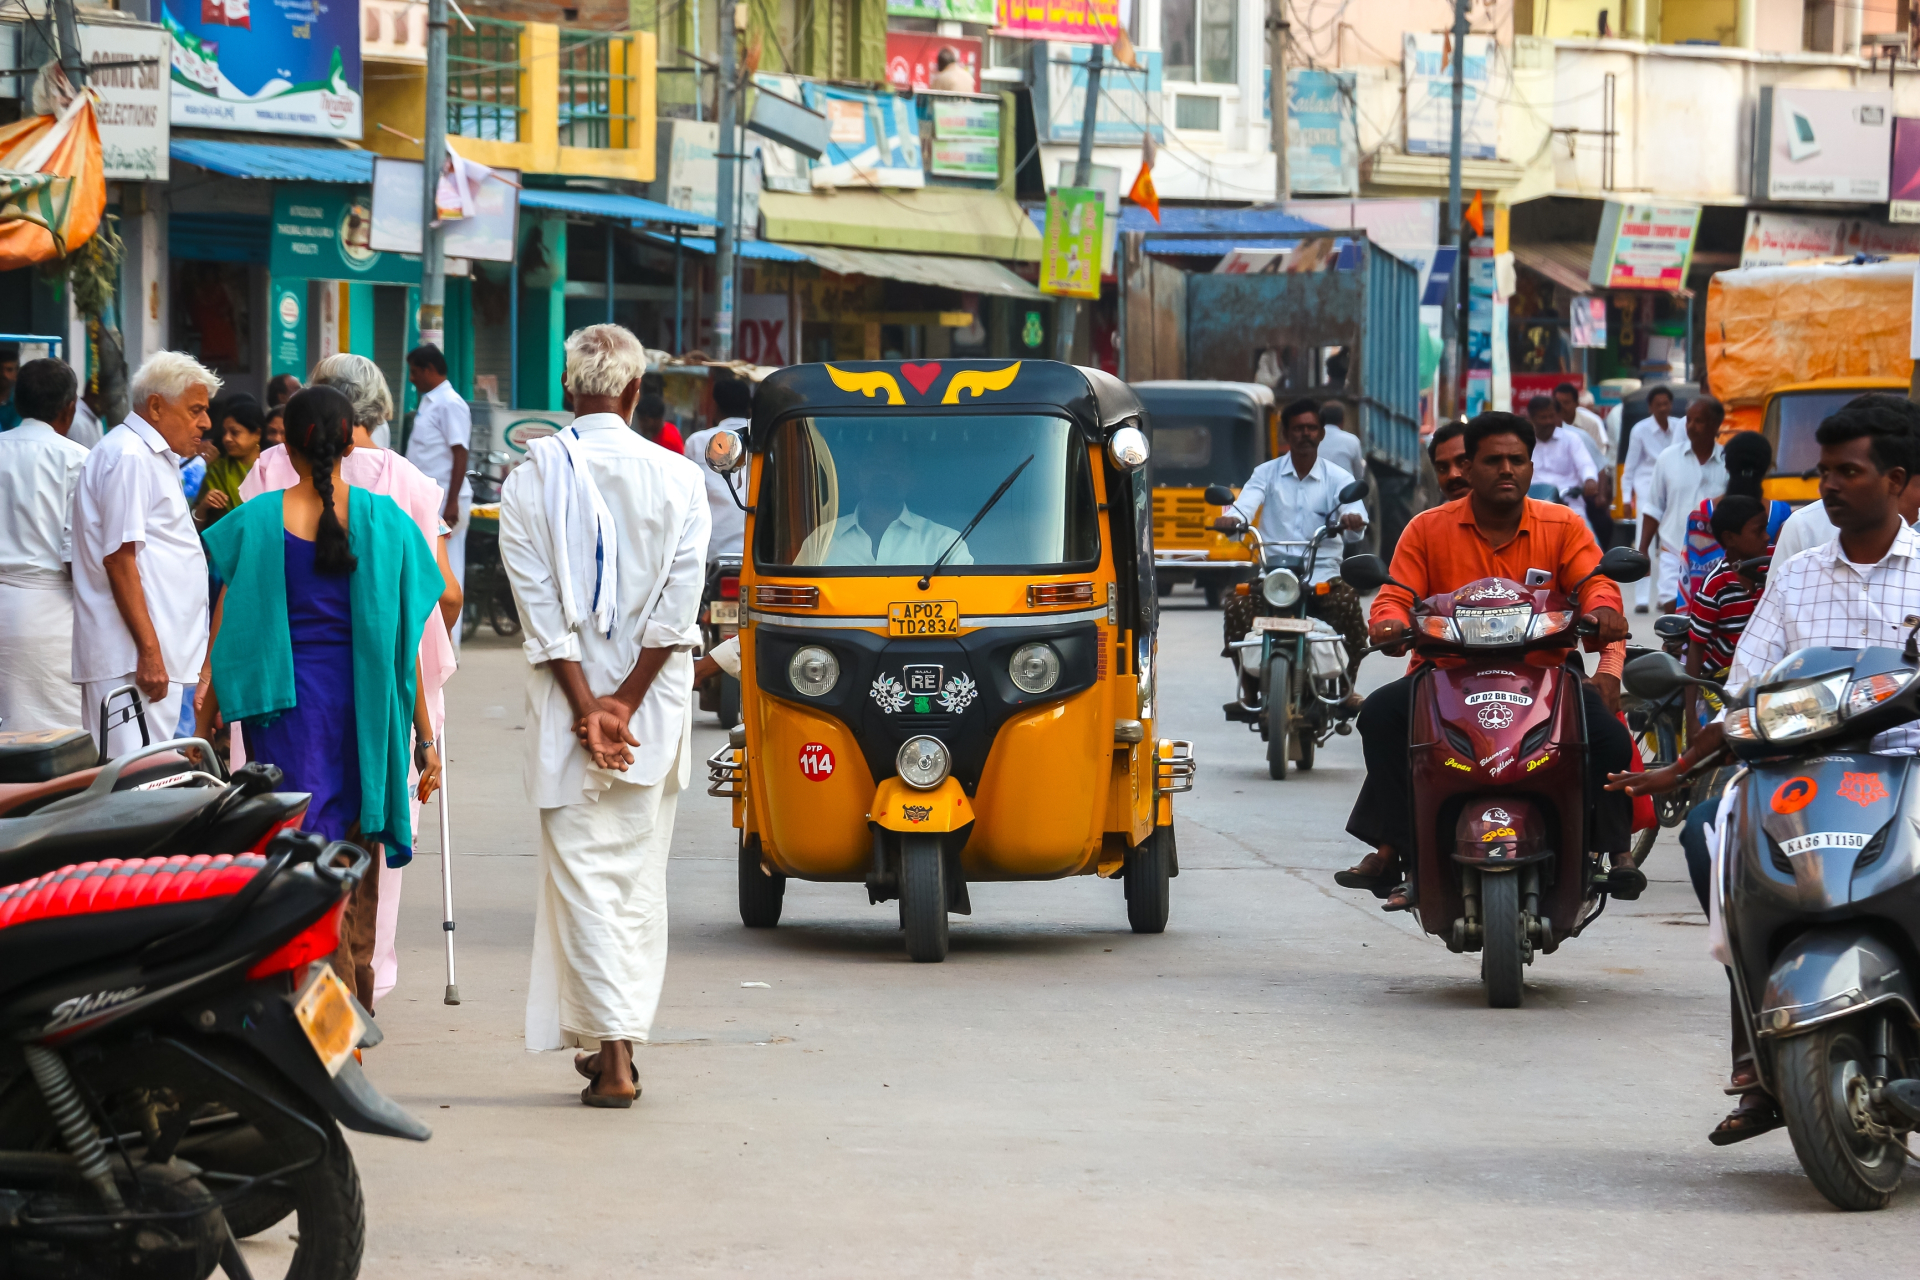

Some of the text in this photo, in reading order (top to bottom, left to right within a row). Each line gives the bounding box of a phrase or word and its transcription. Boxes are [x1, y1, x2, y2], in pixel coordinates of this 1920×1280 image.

[96, 101, 158, 127] SELECTIONS
[904, 604, 943, 618] AP02
[897, 619, 957, 634] TD2834
[1476, 669, 1517, 677] HONDA
[911, 674, 936, 689] RE
[1470, 692, 1528, 704] AP 02 BB 1867
[800, 753, 833, 775] 114
[1444, 757, 1471, 772] Pavan
[1489, 755, 1515, 778] Pallavi
[1526, 752, 1550, 772] Devi
[1803, 756, 1856, 765] HONDA
[43, 985, 146, 1031] Shine
